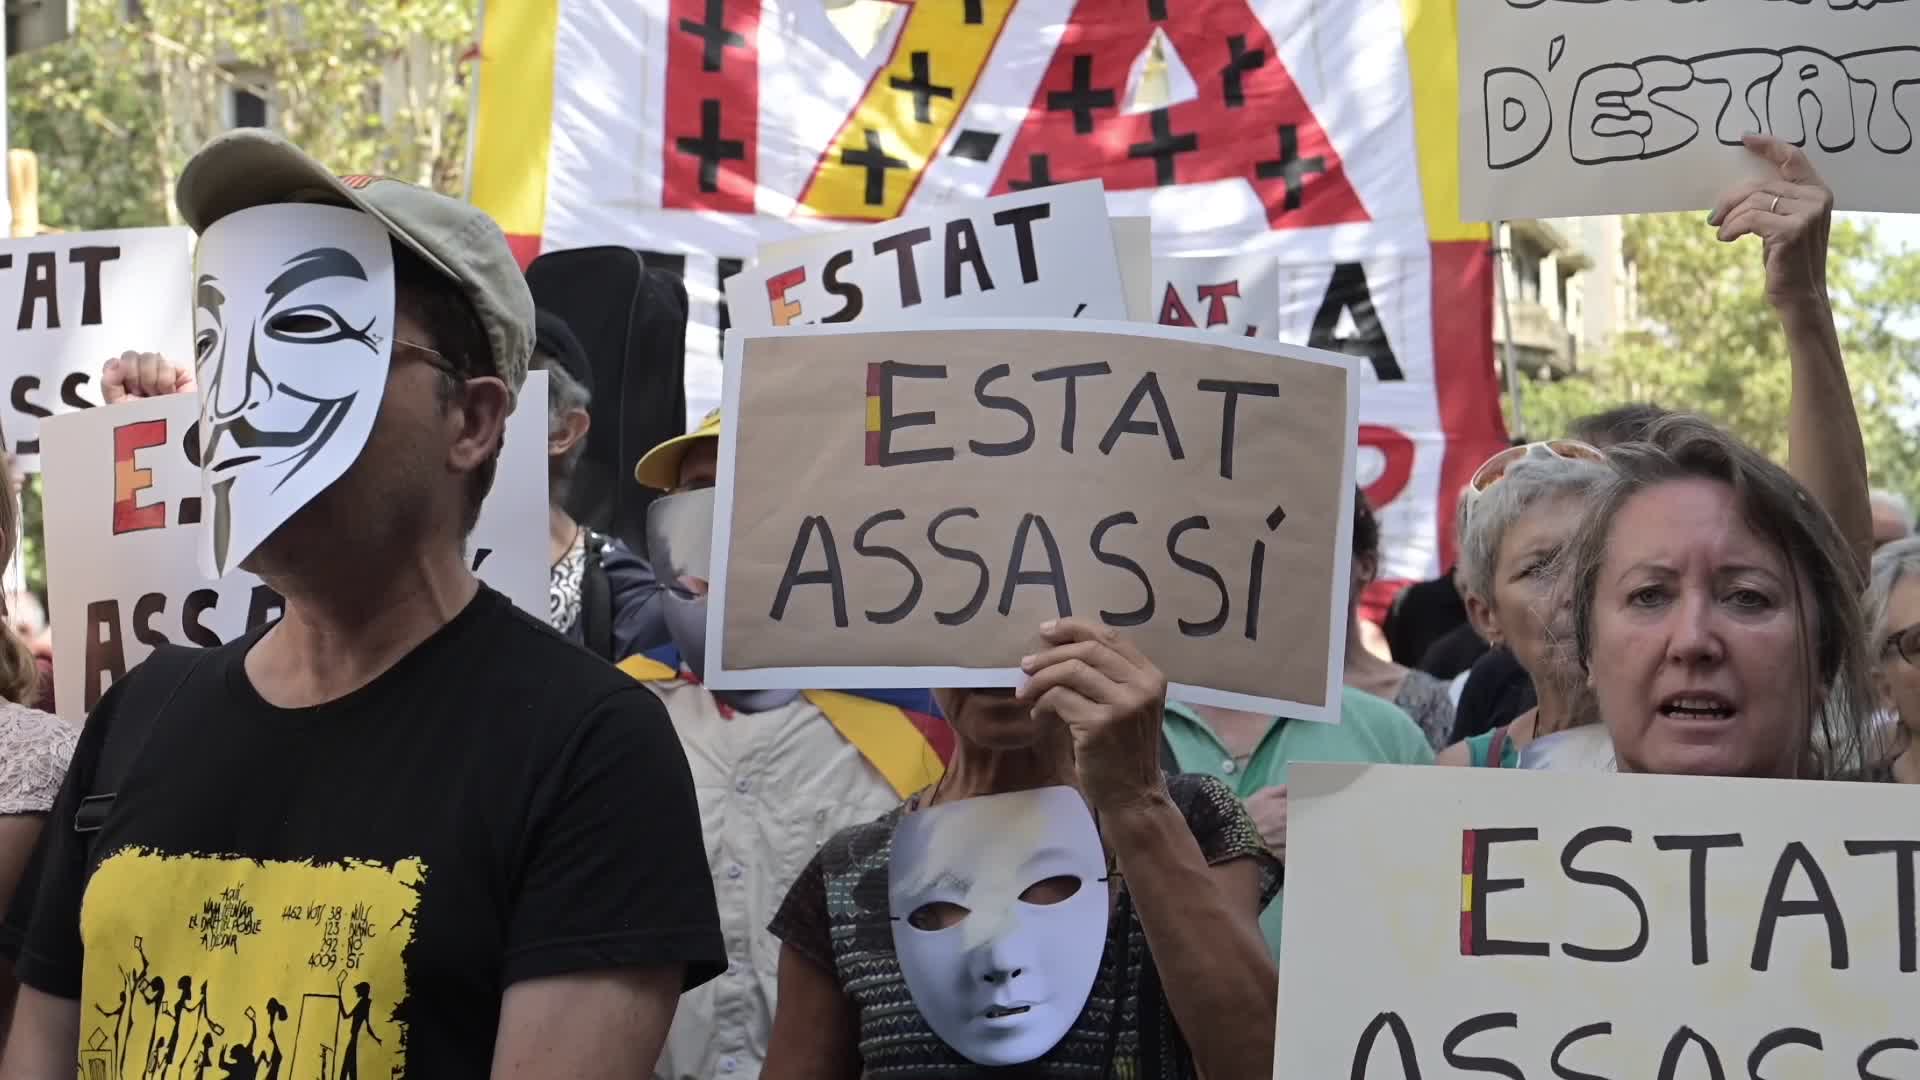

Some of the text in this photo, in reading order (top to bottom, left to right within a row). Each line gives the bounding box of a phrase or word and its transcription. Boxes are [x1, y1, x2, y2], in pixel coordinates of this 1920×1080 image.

[0, 246, 121, 330] AT
[765, 202, 1051, 326] ESTAT
[865, 359, 1280, 480] ESTAT
[769, 505, 1287, 641] ASSASSÍ
[323, 921, 340, 940] 123
[328, 905, 342, 921] 38
[1460, 826, 1920, 973] ESTAT
[308, 952, 365, 971] 4009 SÍ
[347, 936, 363, 954] NO
